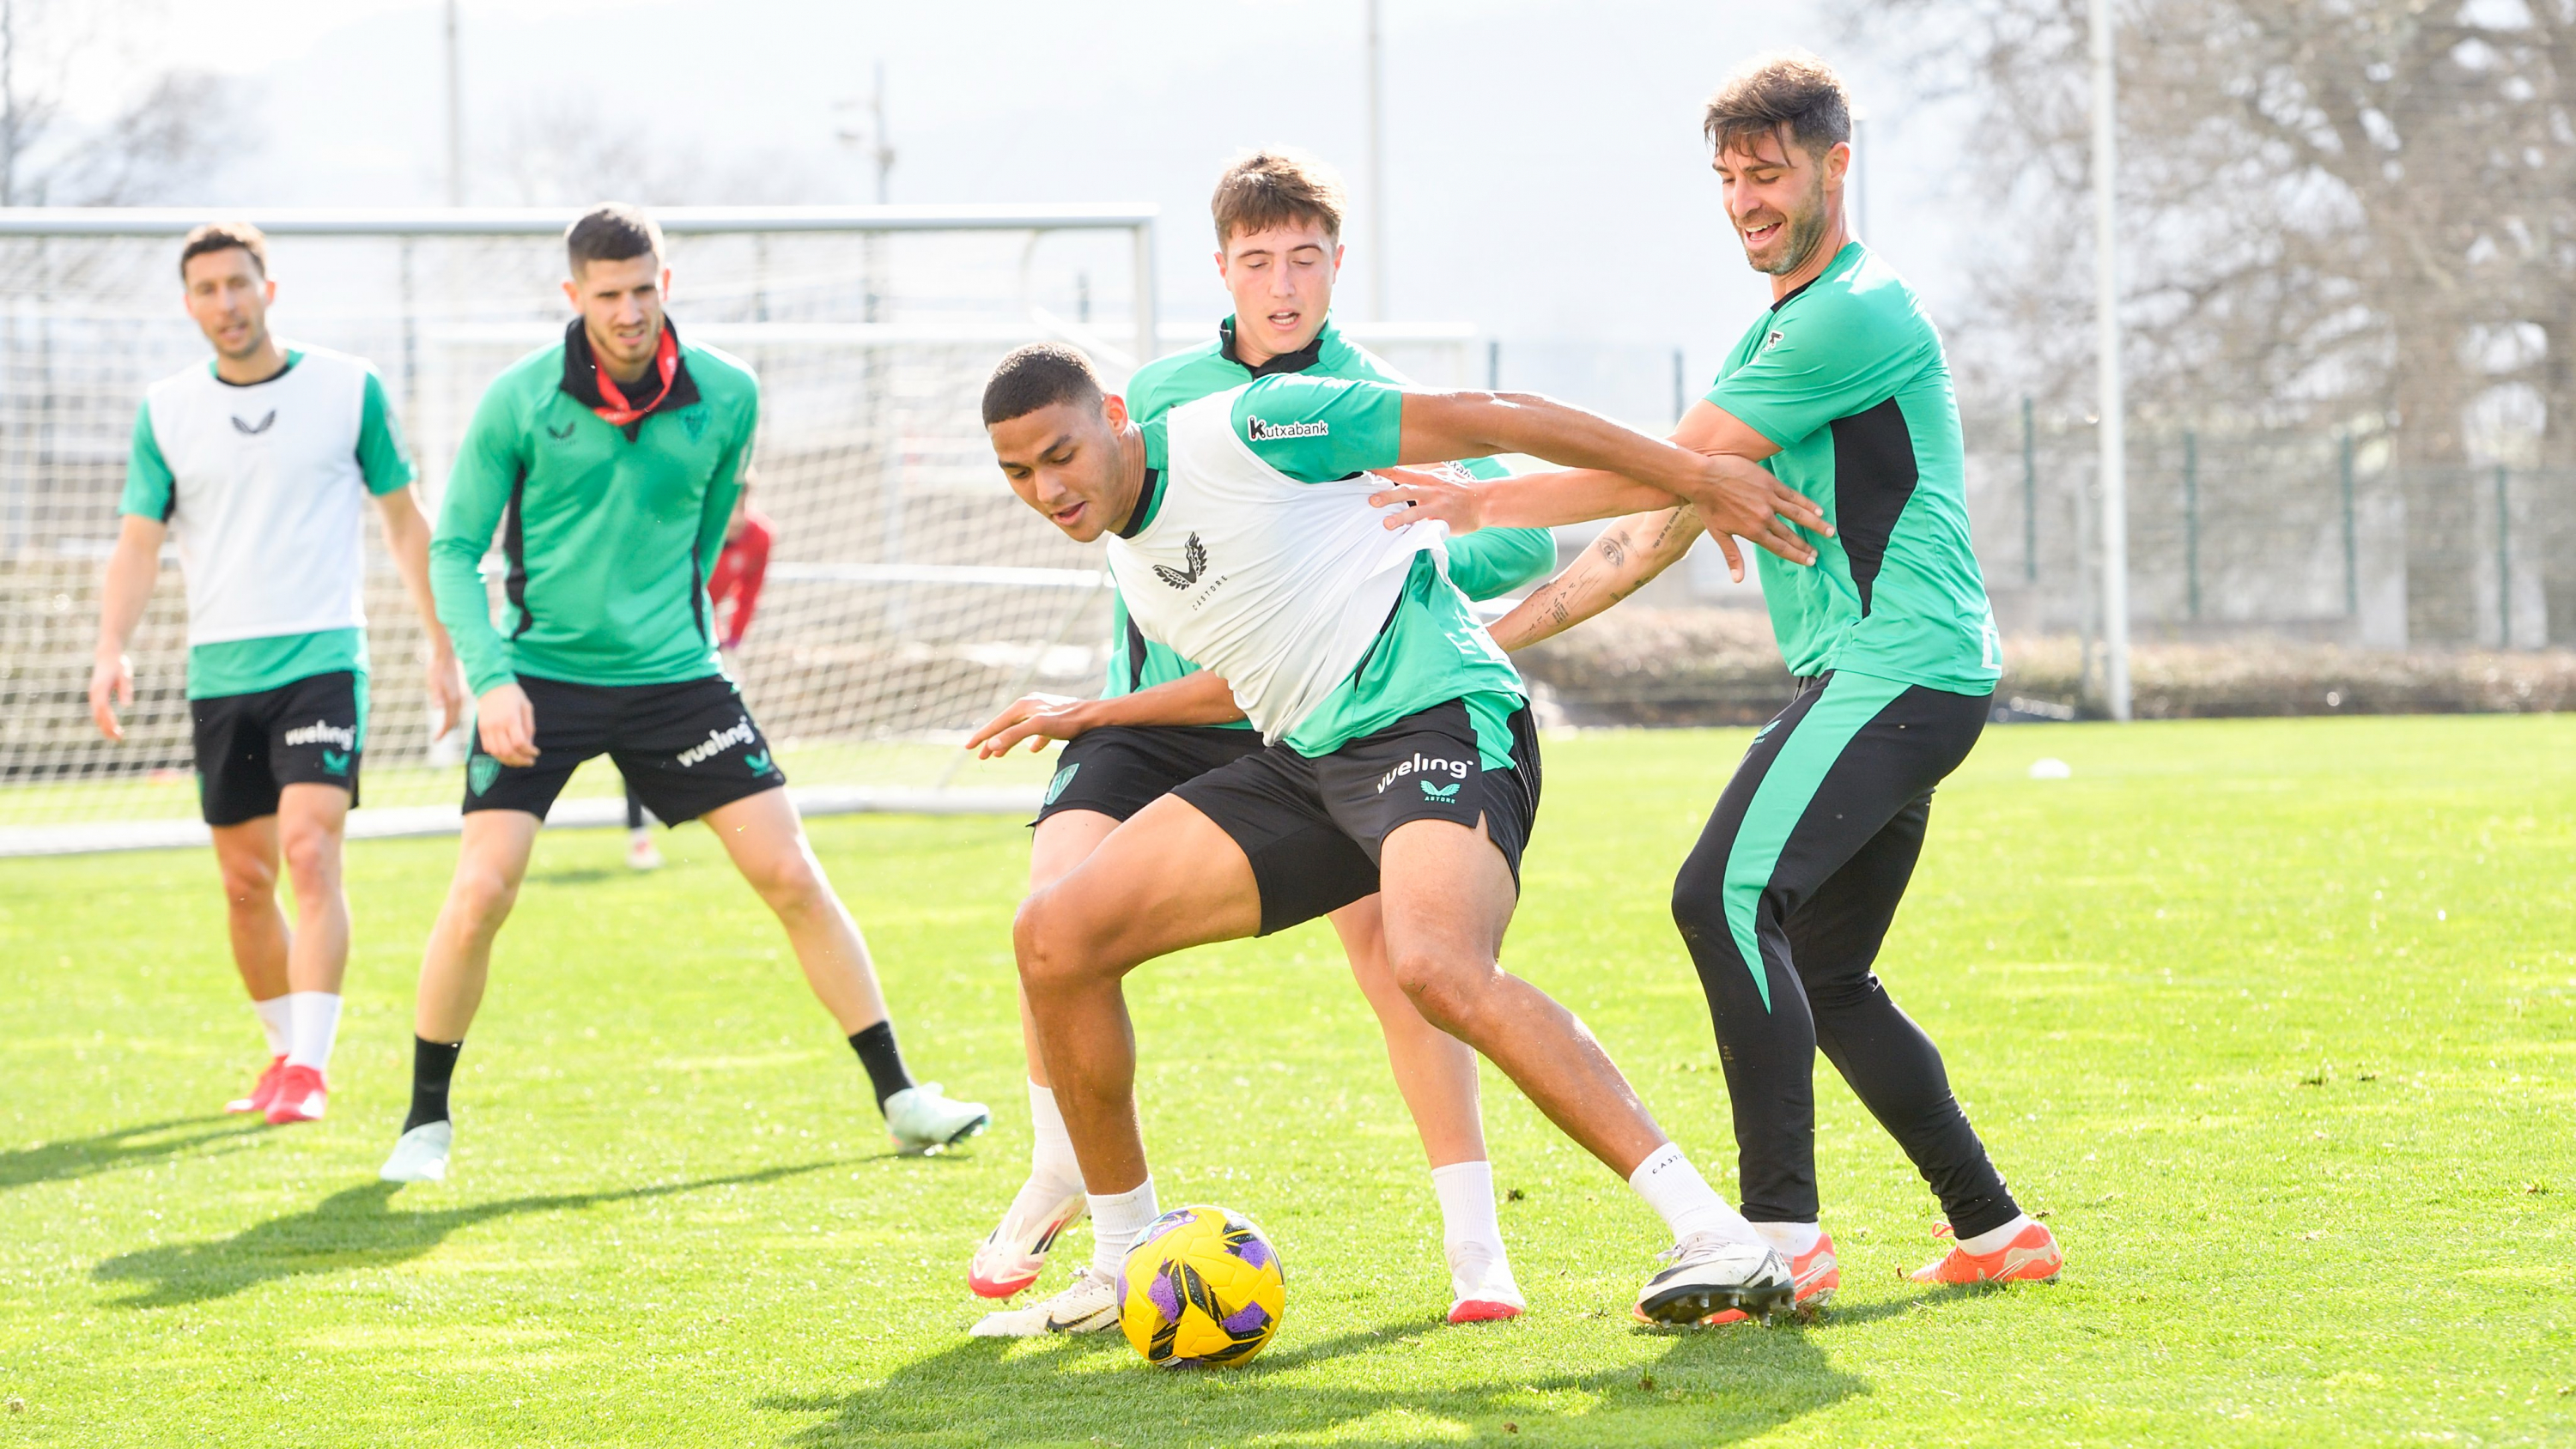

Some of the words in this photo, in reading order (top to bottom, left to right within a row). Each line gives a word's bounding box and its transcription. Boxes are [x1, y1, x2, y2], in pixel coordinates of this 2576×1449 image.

[1193, 575, 1228, 611] CASTORE
[285, 718, 354, 752] vueling
[677, 721, 755, 767] vueling
[1376, 752, 1468, 795] vueling
[1152, 1219, 1184, 1235] LALIGA
